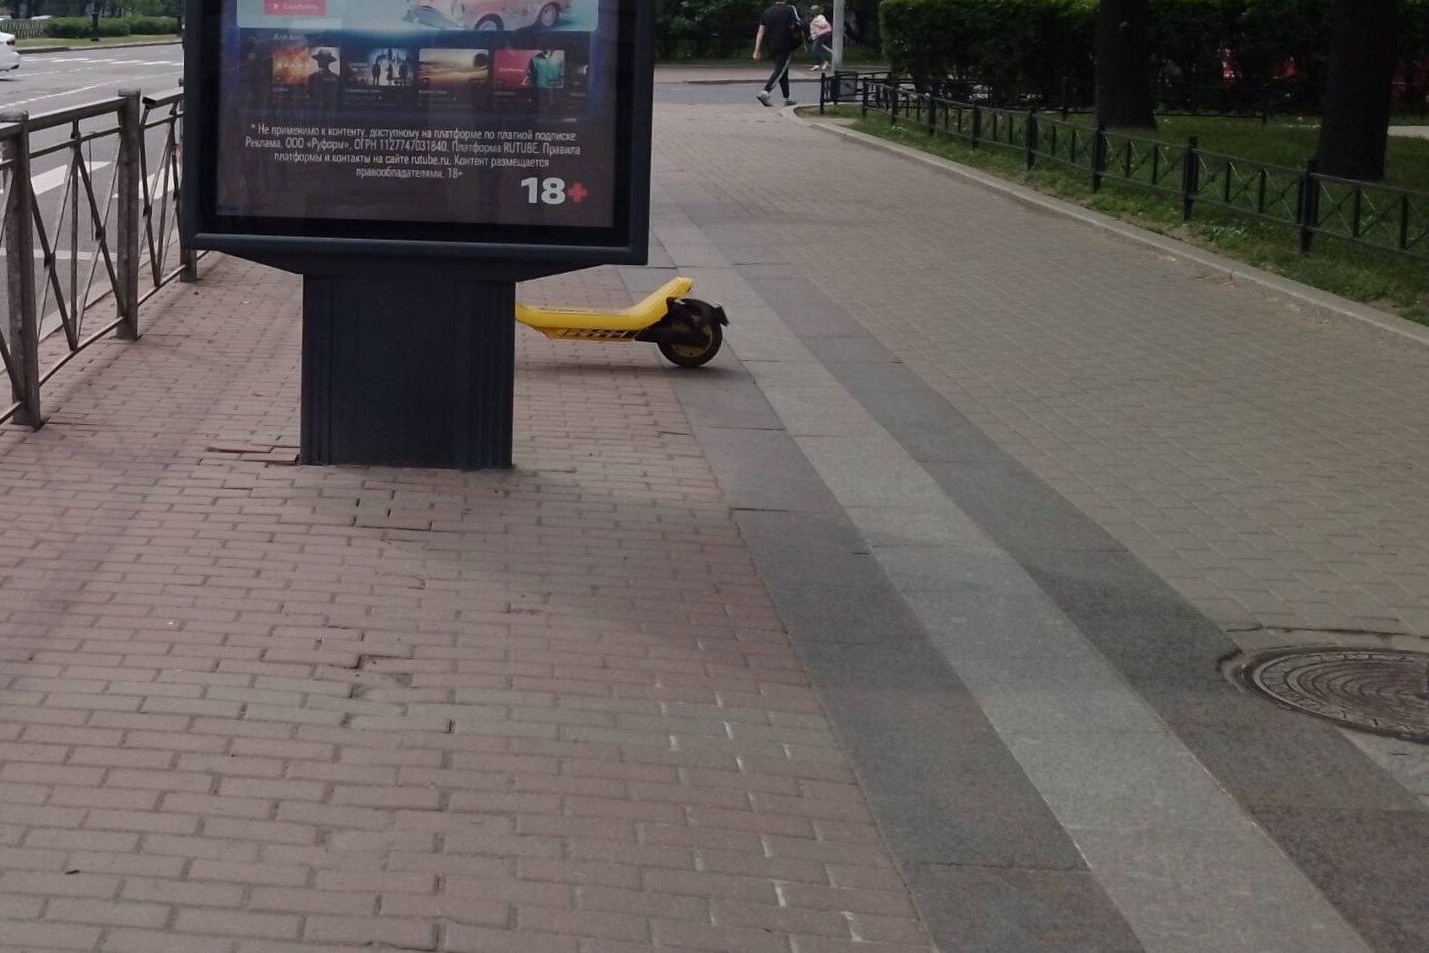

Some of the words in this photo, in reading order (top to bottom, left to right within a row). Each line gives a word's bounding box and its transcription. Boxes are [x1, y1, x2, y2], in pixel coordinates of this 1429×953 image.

[258, 123, 270, 134] Не
[271, 126, 319, 137] применимо
[370, 128, 419, 140] доступному
[421, 130, 432, 138] на
[434, 127, 482, 141] платформе
[484, 131, 495, 139] по
[497, 130, 533, 141] платной
[535, 131, 577, 142] подписке
[285, 137, 305, 148] ООО
[353, 138, 377, 150] ОГРН
[451, 140, 502, 154] Платформа
[542, 142, 581, 157] Правила
[274, 151, 323, 164] платформы
[324, 154, 331, 162] и
[332, 154, 371, 163] контакты
[373, 155, 383, 163] на
[385, 154, 410, 164] сайте
[454, 154, 489, 166] Контент
[490, 158, 550, 169] размещается
[447, 167, 464, 179] 18+
[521, 176, 588, 205] 18+
